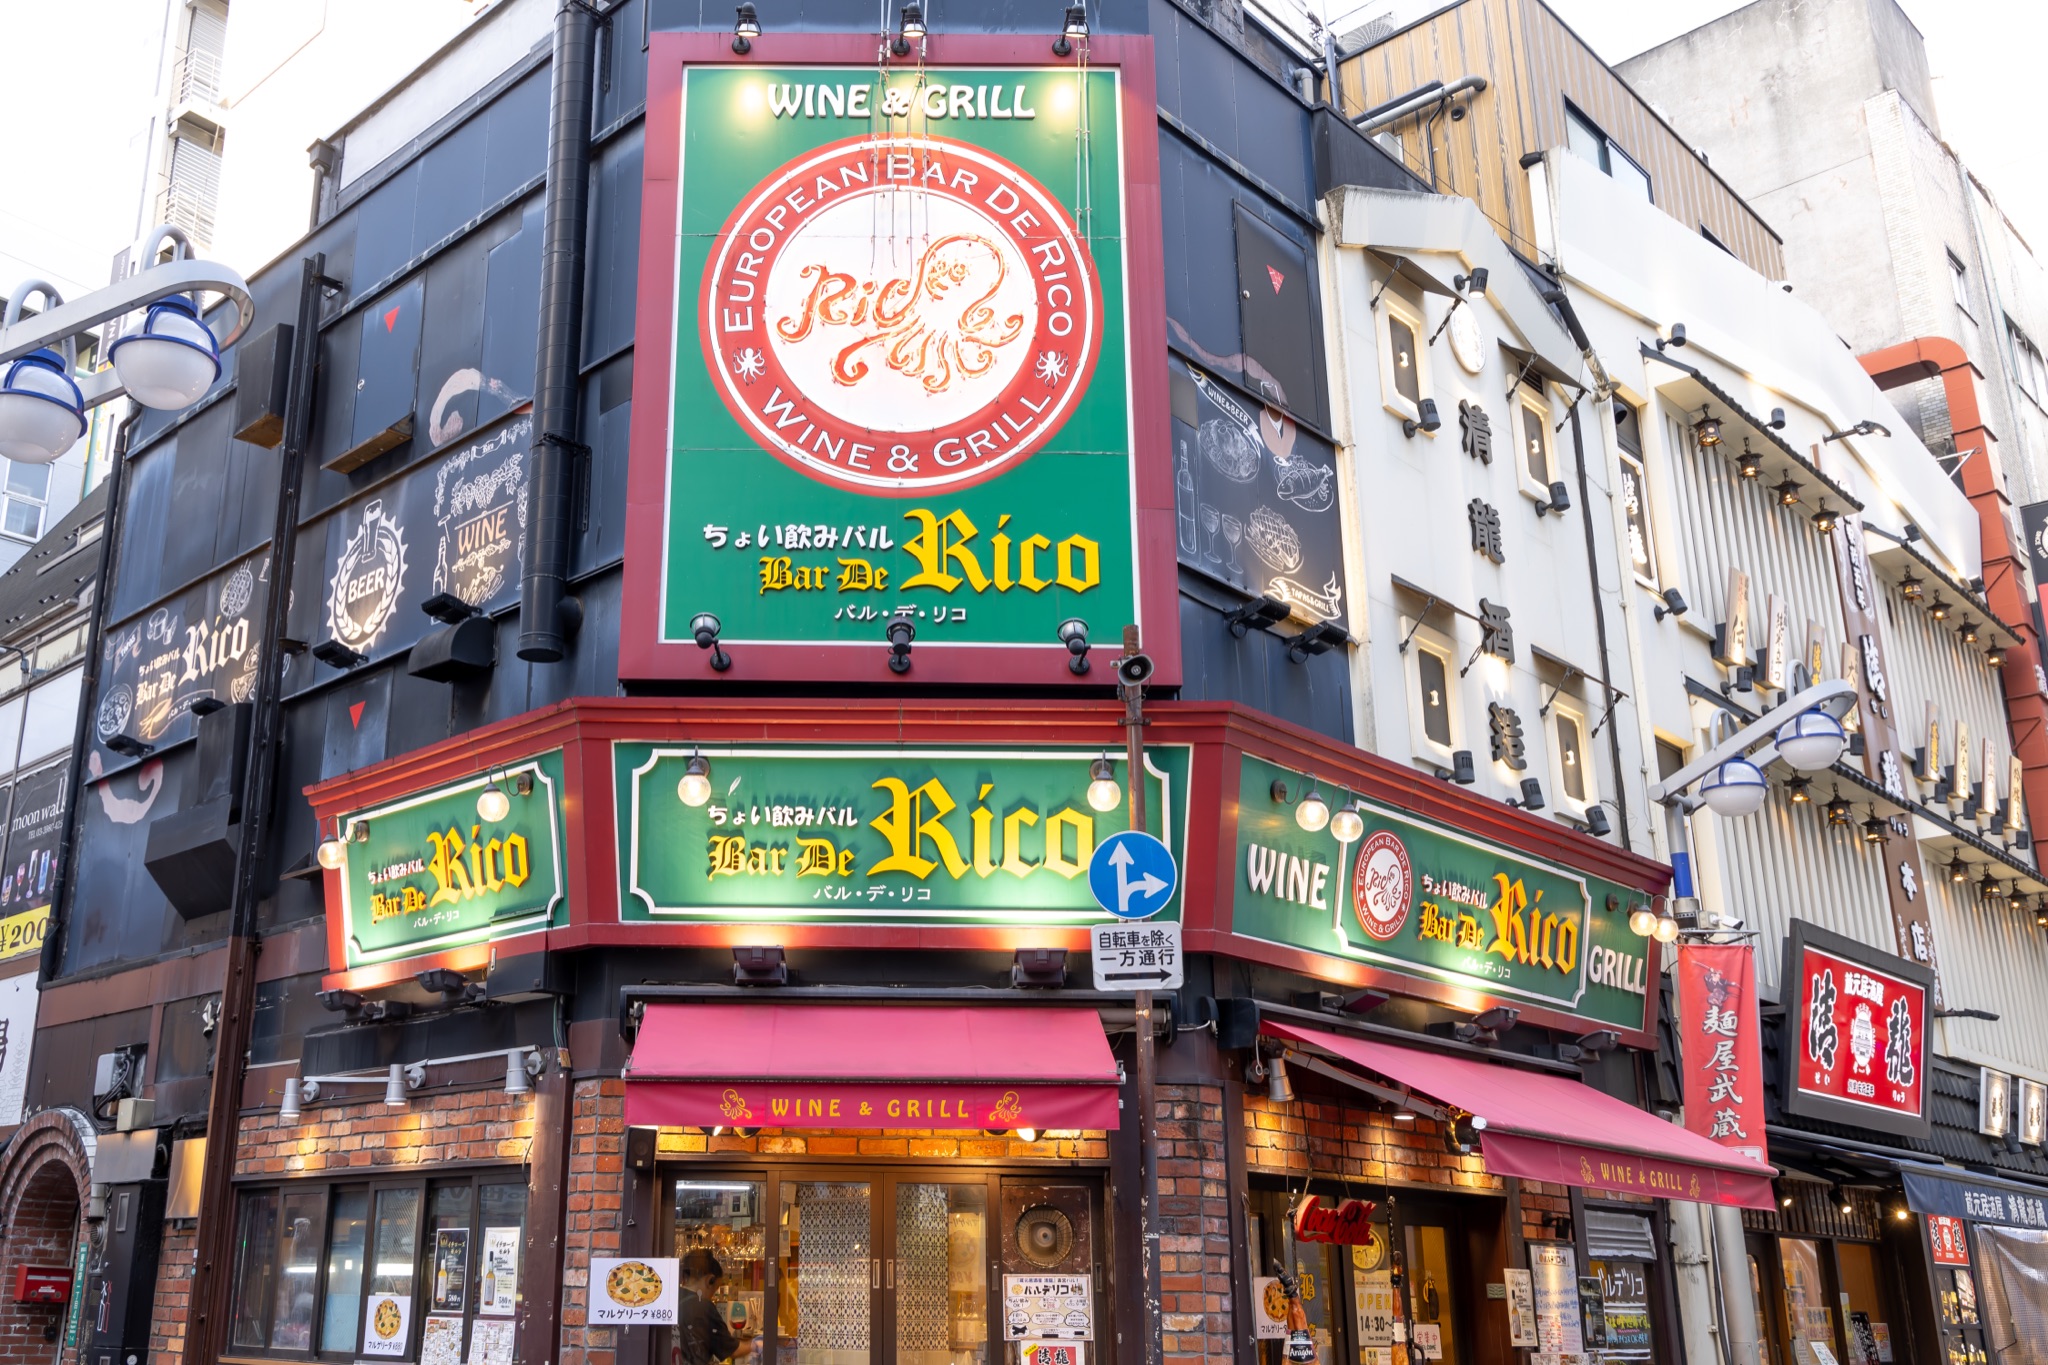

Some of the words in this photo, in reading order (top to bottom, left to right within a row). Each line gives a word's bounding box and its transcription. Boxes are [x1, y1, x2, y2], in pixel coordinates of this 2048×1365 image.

[767, 83, 871, 118] WINE
[886, 86, 911, 117] &
[922, 83, 1036, 119] GRILL
[724, 157, 870, 333] EUROPEAN
[1031, 238, 1072, 338] RICO
[760, 385, 876, 472] WINE
[888, 444, 919, 474] &
[931, 391, 1052, 468] GRILL
[458, 508, 508, 556] WINE
[703, 523, 894, 551] ちょい飲みバル
[758, 556, 829, 598] Bar
[837, 557, 888, 593] De
[899, 508, 1101, 595] Rico
[347, 566, 384, 603] BEER
[178, 616, 249, 687] Rico
[135, 677, 159, 710] Bar
[158, 671, 177, 696] De
[12, 808, 40, 833] moon
[707, 805, 858, 828] ちょい飲みバル
[707, 835, 787, 882] Bar
[794, 837, 855, 879] De
[867, 776, 1095, 880] Rico
[367, 857, 426, 886] ちょい飲みバル
[370, 893, 401, 926] Bar
[401, 886, 427, 916] De
[426, 824, 530, 908] Rico
[1247, 843, 1330, 911] WINE
[813, 884, 932, 902] バル・デ・リコ
[1422, 874, 1488, 909] ちょい飲みバル
[413, 910, 460, 929] バル・デ・リコ
[1417, 901, 1457, 943] Bar
[1456, 912, 1485, 951] De
[1486, 872, 1578, 976] Rico
[1099, 929, 1174, 949] 自転車を除く
[1100, 949, 1175, 967] 一方通行
[1589, 943, 1646, 995] GRILL
[1703, 1005, 1747, 1139] 麺屋武蔵
[772, 1098, 842, 1118] WINE
[859, 1099, 873, 1117] &
[887, 1097, 970, 1119] GRILL
[1600, 1162, 1633, 1184] WINE
[1638, 1170, 1646, 1184] &
[1649, 1170, 1683, 1191] GRILL
[597, 1309, 649, 1319] マルゲリータ
[650, 1309, 673, 1319] ¥880
[1358, 1293, 1392, 1310] OPEN
[368, 1341, 393, 1350] マルゲリータ
